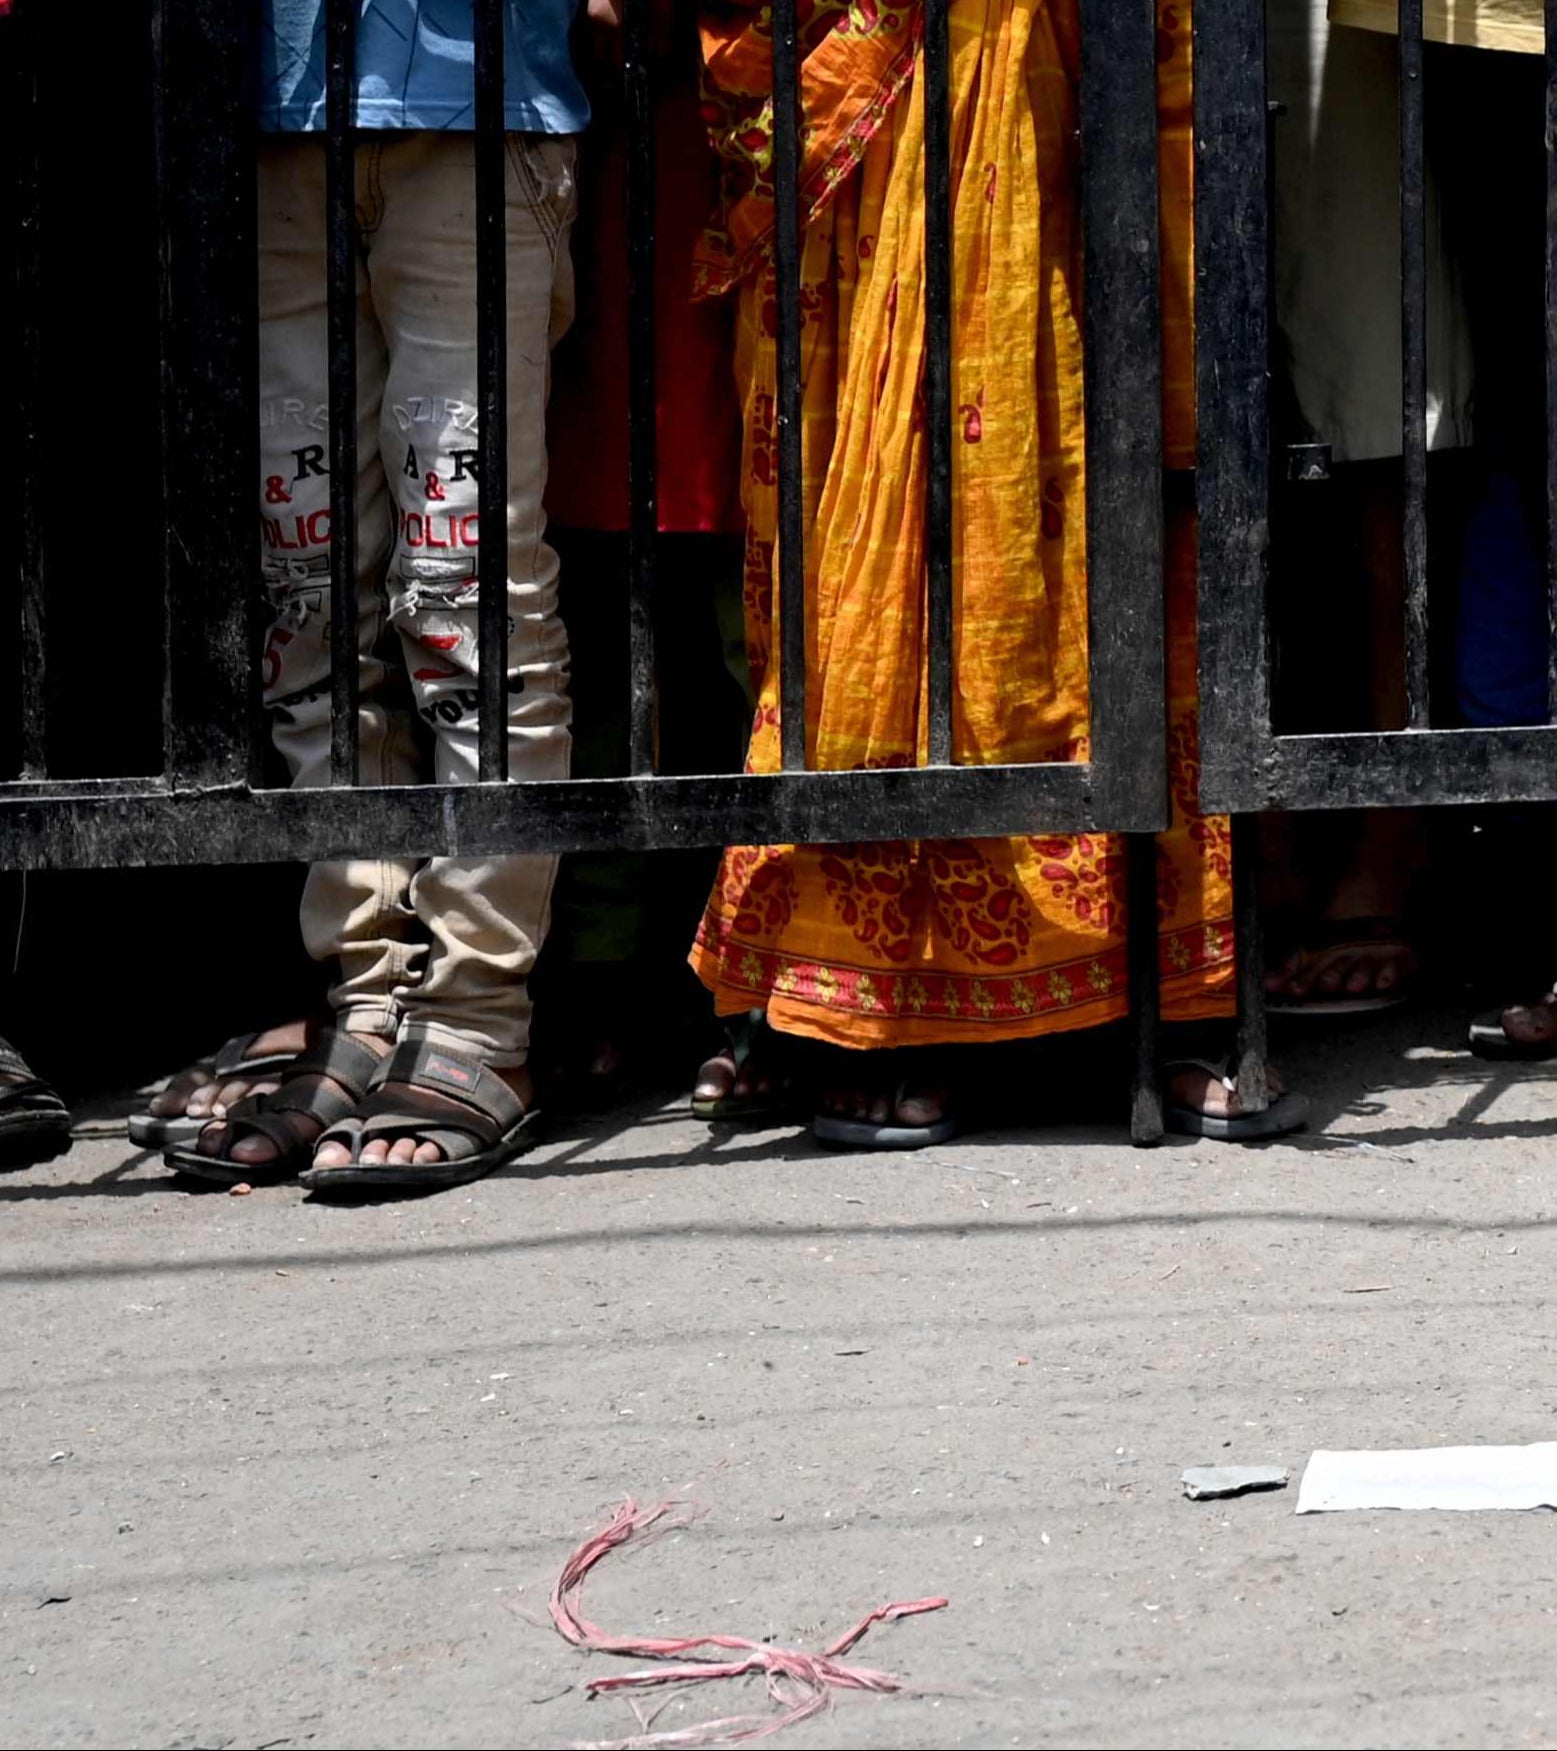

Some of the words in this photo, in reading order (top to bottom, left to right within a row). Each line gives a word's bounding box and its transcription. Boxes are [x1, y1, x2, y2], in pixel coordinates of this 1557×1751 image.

[404, 443, 419, 479] A
[425, 471, 445, 501] &
[400, 508, 482, 548] OLIC
